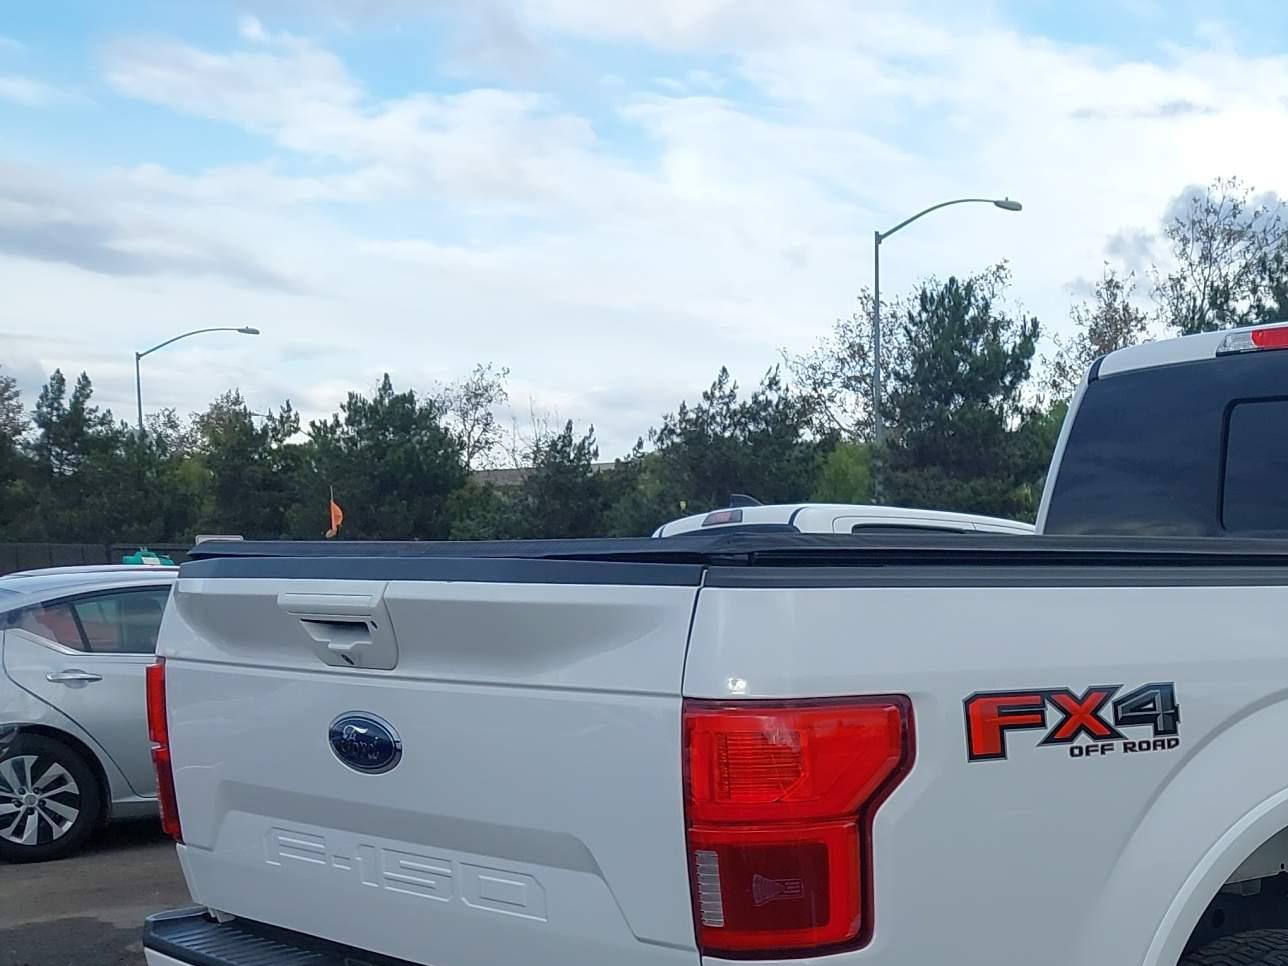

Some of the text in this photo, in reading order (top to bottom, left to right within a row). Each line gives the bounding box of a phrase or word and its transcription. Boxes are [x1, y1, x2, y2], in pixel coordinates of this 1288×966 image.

[962, 681, 1180, 763] FX4
[1069, 737, 1180, 758] OFF ROAD
[264, 826, 548, 922] F-150
